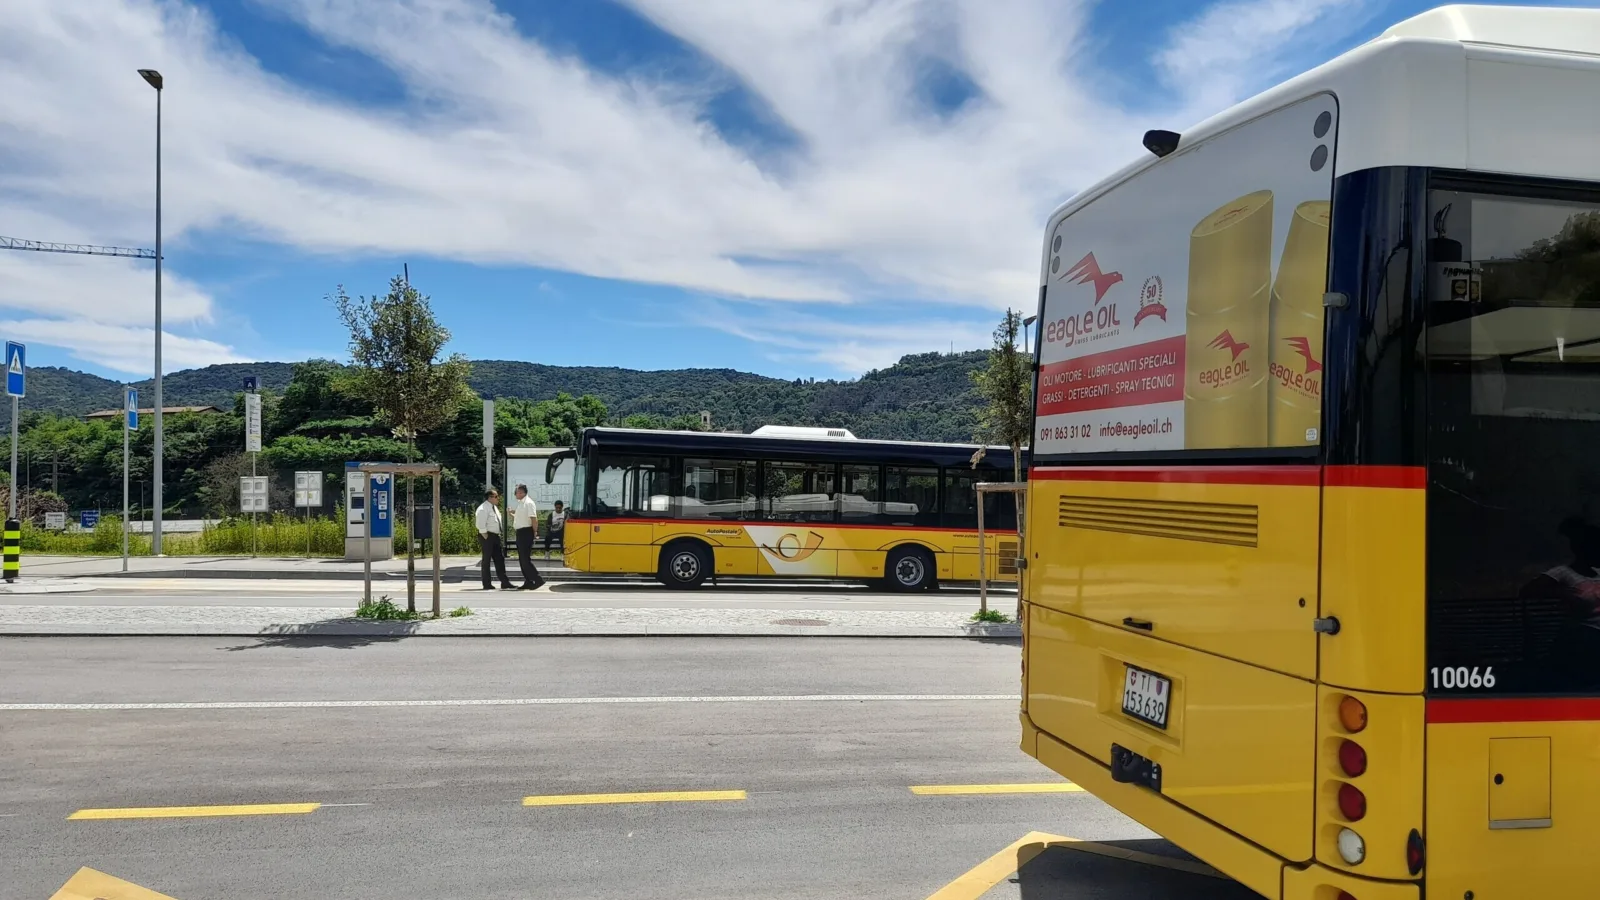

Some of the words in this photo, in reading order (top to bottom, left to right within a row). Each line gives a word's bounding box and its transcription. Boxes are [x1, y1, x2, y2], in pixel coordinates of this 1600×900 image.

[1146, 284, 1156, 299] 50
[1046, 310, 1094, 347] eagle
[1043, 375, 1053, 386] OLI
[1055, 369, 1082, 384] MOTORE
[1088, 360, 1137, 378] LUBRIFICANTI
[1139, 352, 1176, 370] SPECIALI
[1200, 366, 1232, 388] eagle
[1269, 362, 1303, 388] eagle
[1042, 391, 1063, 404] GRASSI
[1068, 384, 1110, 401] DETERGENTI
[1116, 379, 1140, 394] SPRAY
[1142, 374, 1175, 390] TECNICI
[1040, 428, 1052, 440] 091
[1055, 426, 1068, 440] 863
[1070, 425, 1078, 438] 31
[1081, 424, 1091, 438] 02
[1099, 417, 1172, 439] info@eagleoil.ch
[1142, 675, 1150, 692] TI
[1431, 666, 1496, 688] 10066
